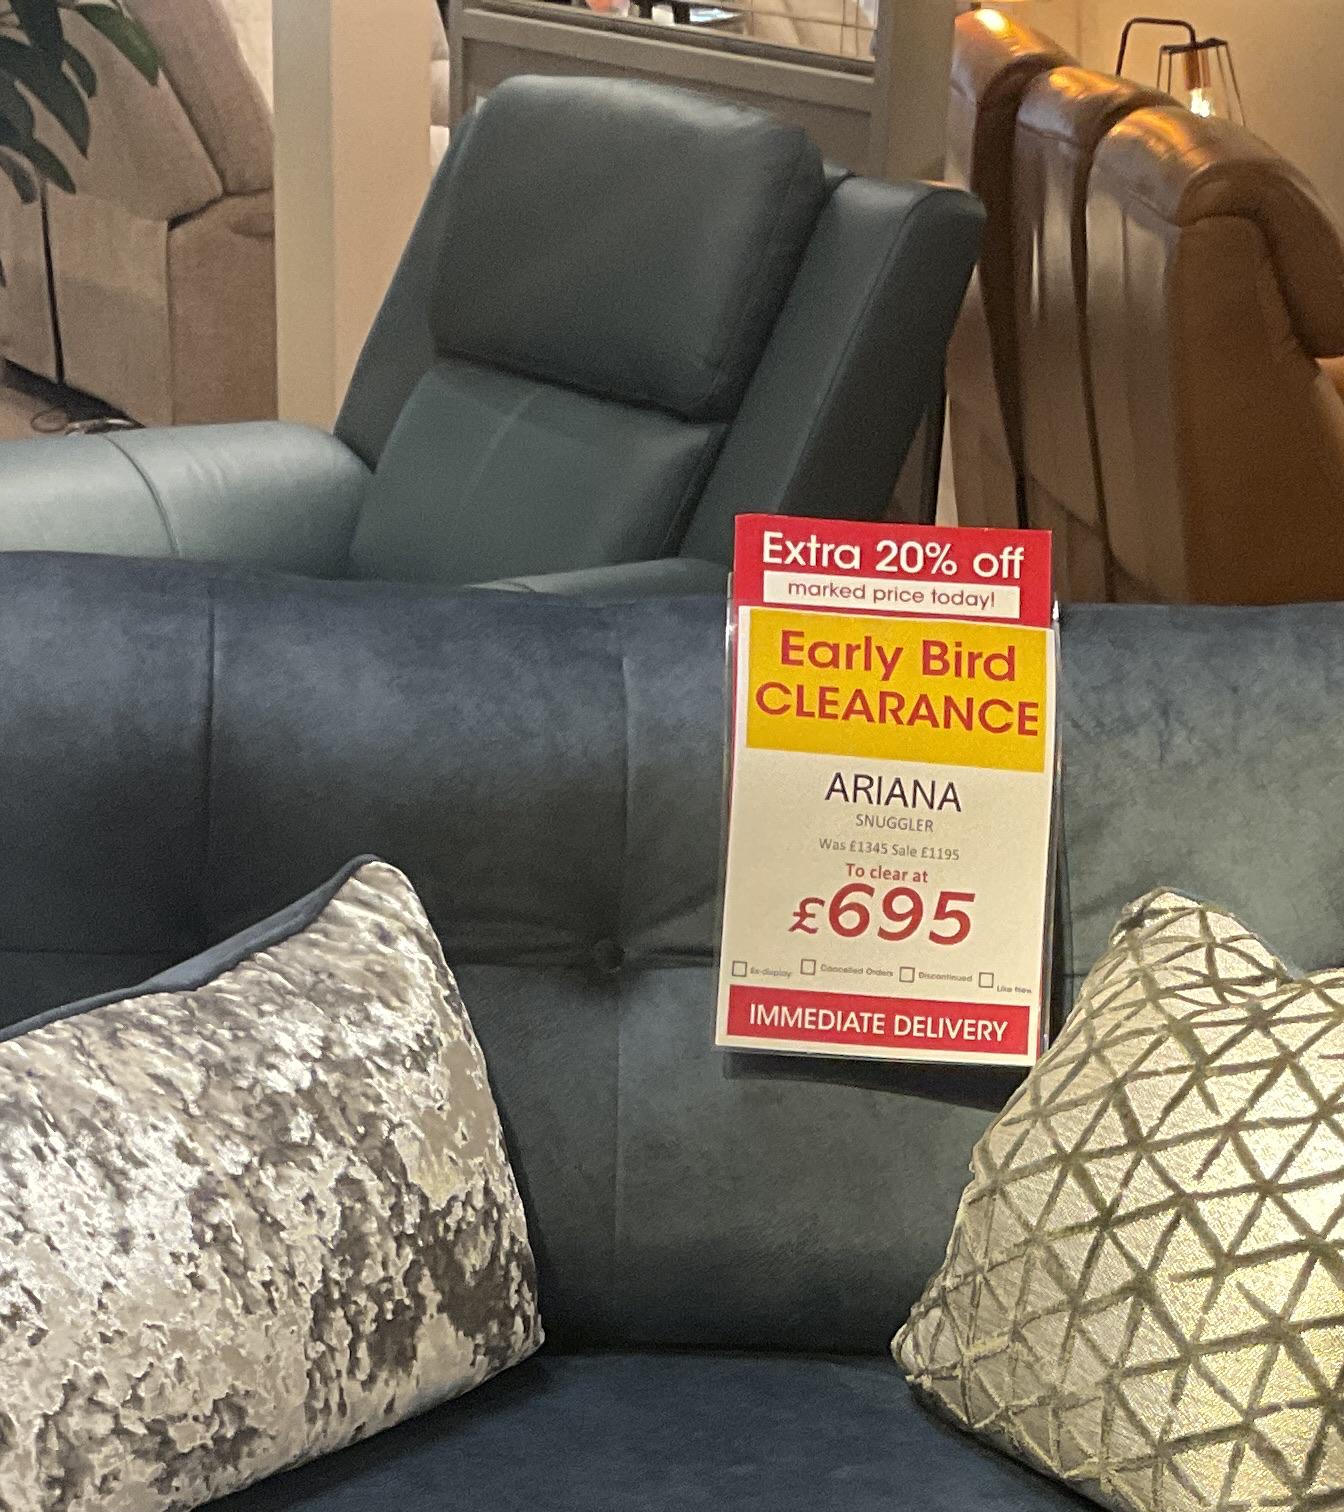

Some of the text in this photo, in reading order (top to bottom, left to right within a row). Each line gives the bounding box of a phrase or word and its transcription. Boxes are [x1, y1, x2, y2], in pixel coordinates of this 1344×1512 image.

[762, 531, 1024, 579] Extra 20% off
[788, 581, 995, 610] marked price today!
[781, 629, 1015, 682] Early Bird
[755, 681, 1039, 736] CLEARANCE
[825, 772, 961, 812] ARIANA
[856, 814, 934, 832] SNUGGLER
[819, 838, 960, 860] Was £1345 Sale £1195
[846, 863, 928, 883] To clear at
[788, 882, 976, 945] £695
[749, 1004, 1008, 1042] IMMEDIATE DELIVERY
